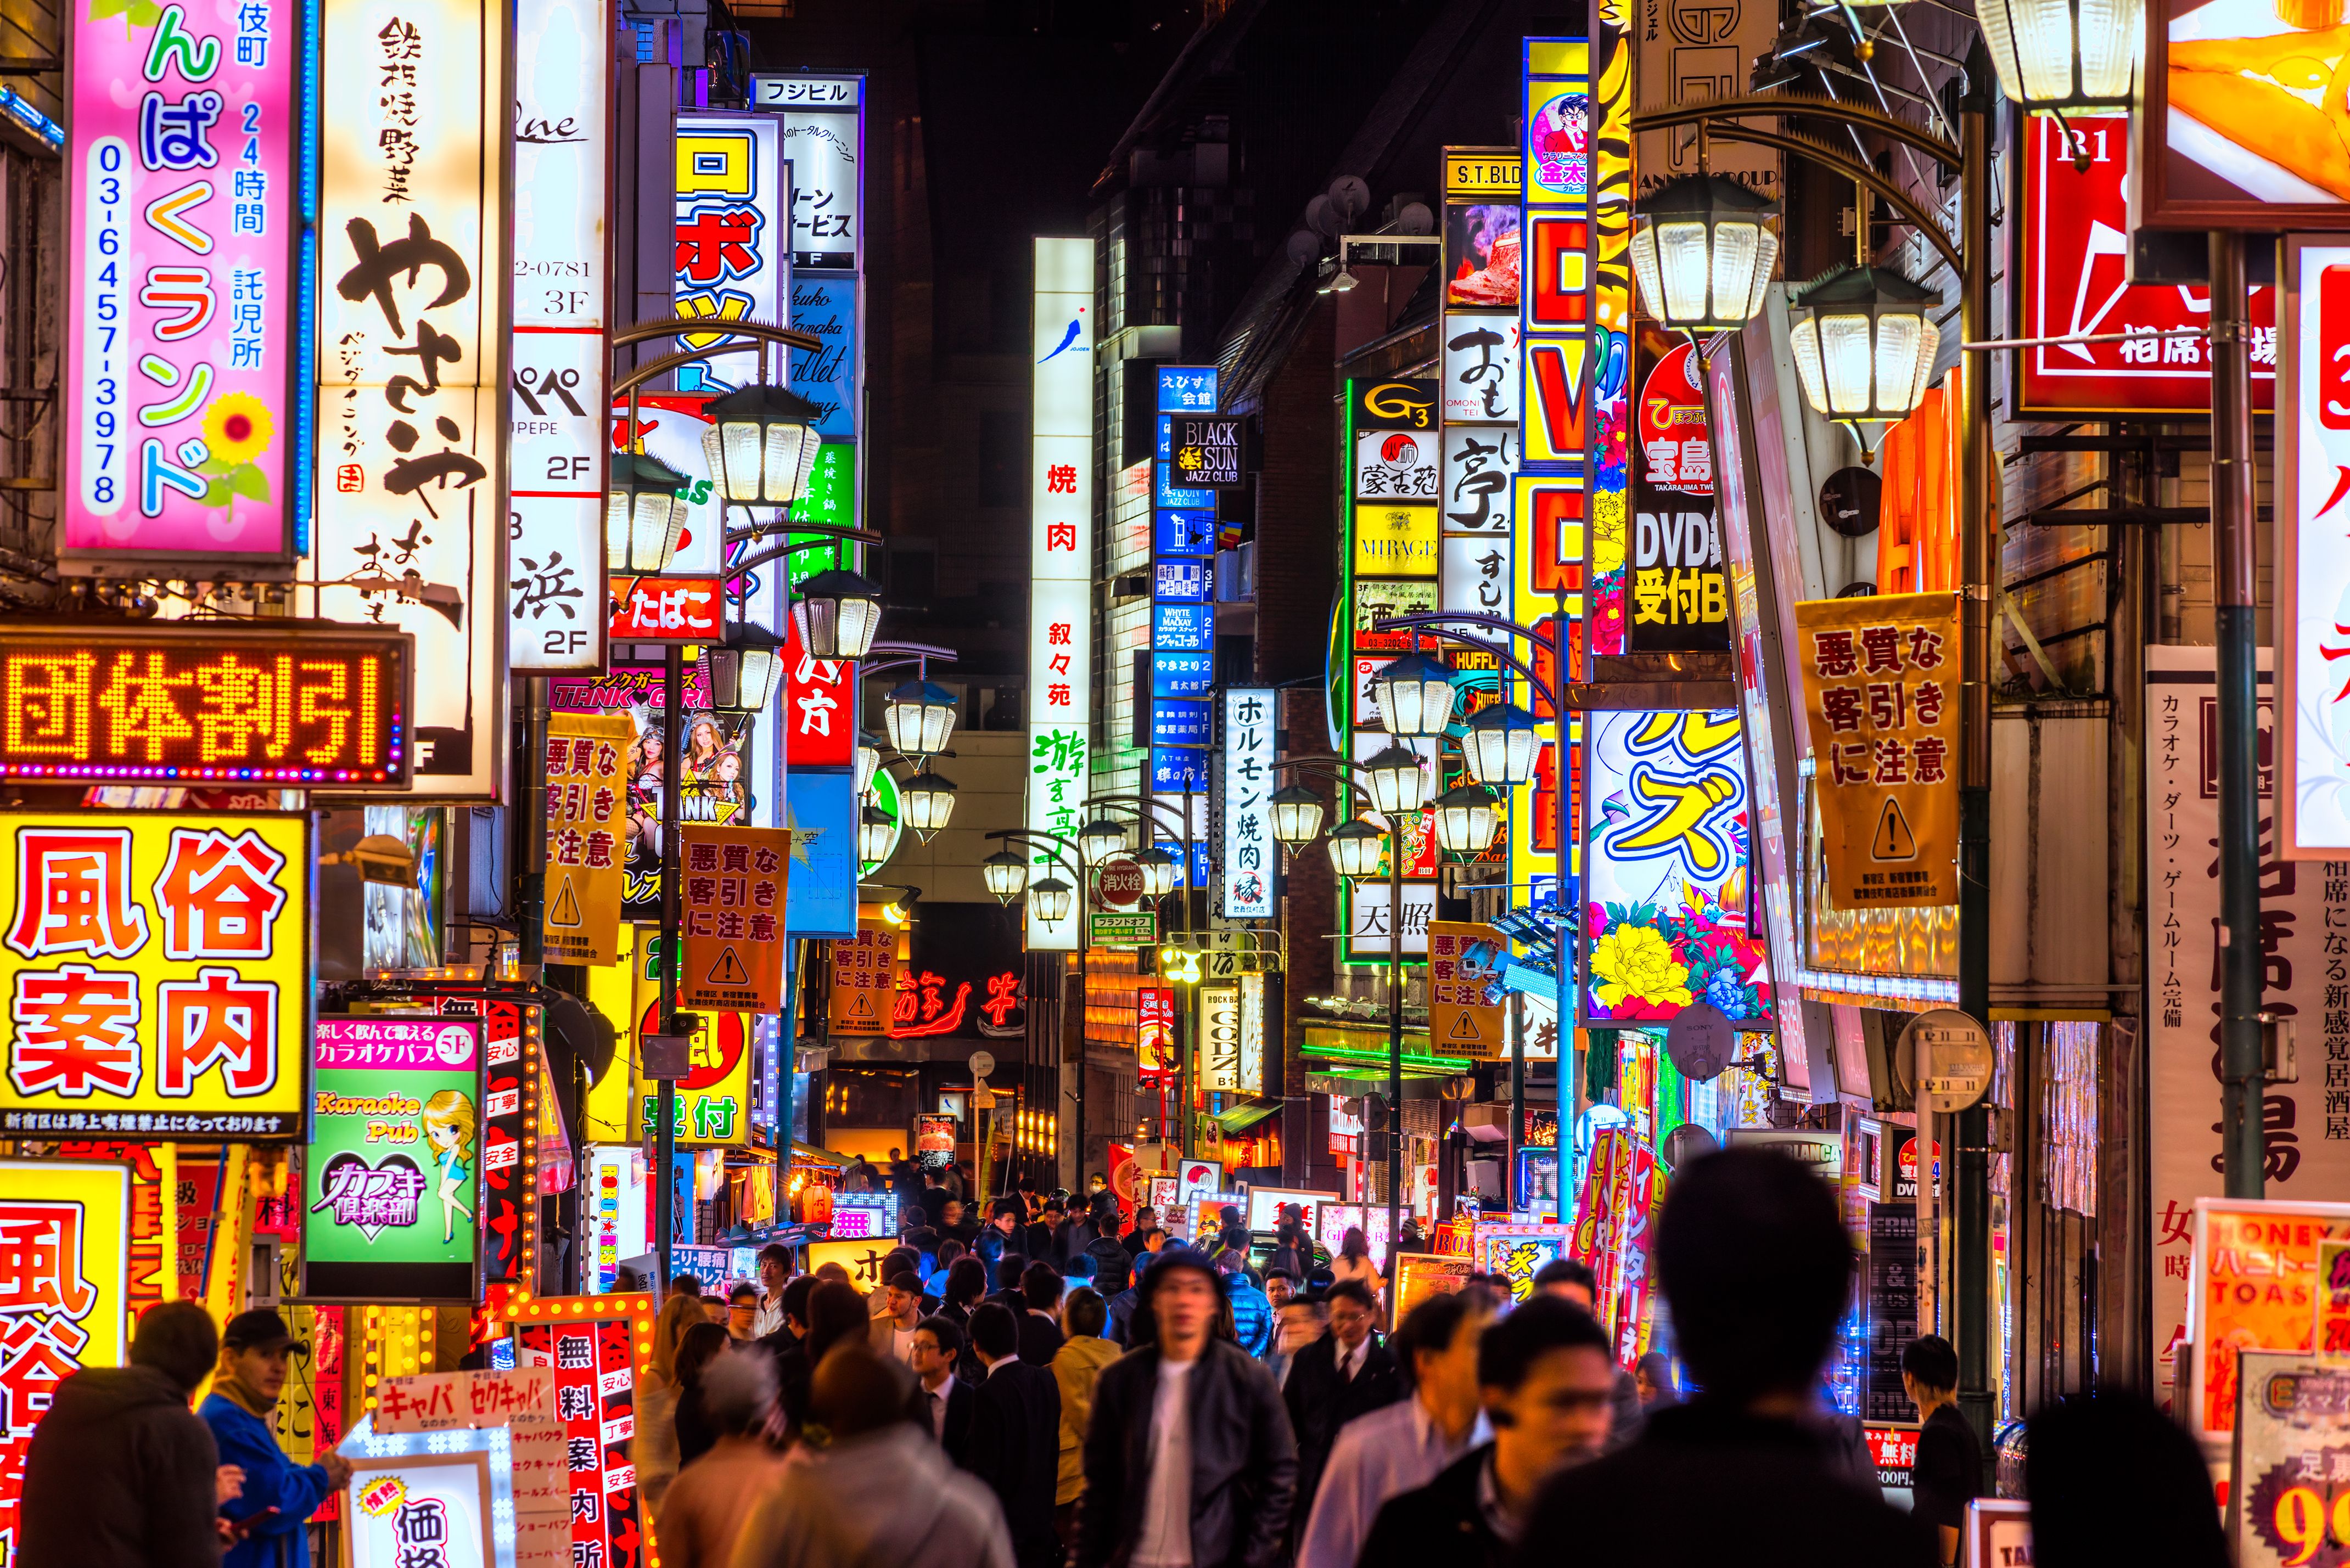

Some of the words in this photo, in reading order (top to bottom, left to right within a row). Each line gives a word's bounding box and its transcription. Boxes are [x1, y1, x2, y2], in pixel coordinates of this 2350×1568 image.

[236, 0, 269, 68] 伎町
[767, 83, 848, 102] フジビル
[378, 16, 423, 205] 鉄板焼野菜
[231, 103, 267, 235] 24時間
[1540, 161, 1588, 186] 金太
[543, 289, 590, 314] 3F
[94, 144, 121, 503] 03-6457-3978
[228, 268, 266, 370] 託児所
[336, 211, 487, 519] やさいや
[339, 331, 364, 457] ベジダイニング
[1161, 375, 1204, 389] えびす
[1181, 391, 1211, 406] 会館
[1446, 399, 1480, 407] OMONI
[1185, 422, 1238, 446] BLACK
[1204, 446, 1238, 470] SUN
[1386, 441, 1415, 464] 火鍋
[1646, 436, 1712, 483] 宝島
[547, 456, 590, 480] 2F
[1186, 470, 1211, 482] JAZZ
[1212, 470, 1238, 482] CLUB
[1360, 465, 1438, 495] 蒙古苑
[1446, 437, 1507, 529] 亭
[1654, 483, 1698, 492] TAKARAJIMA
[1047, 464, 1077, 552] 焼肉
[1361, 539, 1437, 557] MIRAGE
[1636, 512, 1722, 568] DVD
[1159, 566, 1174, 580] 麻雀
[1192, 567, 1199, 579] 3F
[1204, 569, 1213, 592] 3F
[1158, 582, 1199, 595] 紳士倶楽部
[631, 589, 713, 630] たばこ
[1163, 617, 1192, 626] MACKAY
[1164, 608, 1190, 617] WHYTE
[1204, 617, 1212, 639] 2F
[543, 630, 588, 655] 2F
[1813, 625, 1944, 679] 悪質な
[1048, 622, 1072, 706] 叙々苑
[1156, 660, 1199, 671] やきとり
[1449, 651, 1499, 670] SHUFFL
[5, 652, 382, 765] 団体割引
[554, 685, 632, 709] TANK
[1820, 681, 1944, 734] 客引き
[1156, 725, 1198, 734] 梅屋薬局
[546, 738, 617, 779] 悪質な
[1830, 735, 1947, 787] に注意
[1237, 697, 1263, 871] ホルモン焼肉
[1421, 813, 1434, 833] 和風
[689, 842, 780, 875] 悪質な
[1414, 835, 1426, 859] パブ
[2162, 695, 2181, 1028] カラオケ・ダーツ・ゲームルーム完備
[3, 825, 287, 960] 風俗
[688, 876, 777, 908] 客引き
[1103, 873, 1142, 892] 消火栓
[1099, 918, 1146, 926] ブランドオフ
[1233, 906, 1265, 914] 歌舞伎町店
[1356, 902, 1432, 936] 天照
[686, 909, 777, 943] に注意
[835, 949, 893, 968] 客引き
[834, 969, 892, 990] に注意
[696, 990, 717, 998] 新宿区
[1207, 996, 1227, 1004] ROCK
[6, 963, 279, 1098] 案内
[316, 1024, 436, 1041] 楽しく飲んで歌える
[316, 1043, 436, 1063] カラオケパブ
[439, 1033, 469, 1055] 5F
[486, 1044, 518, 1063] 安心
[1218, 1077, 1233, 1086] B1
[315, 1091, 421, 1116] Karaoke
[487, 1094, 517, 1114] 丁寧
[365, 1119, 419, 1145] Pub
[486, 1145, 518, 1165] 安全
[599, 1164, 620, 1221] ROBOT
[333, 1195, 418, 1227] 倶楽部
[2212, 1222, 2334, 1246] HONEY
[603, 1373, 631, 1392] 安心
[382, 1384, 454, 1420] キャバ
[605, 1420, 633, 1440] 丁寧
[556, 1334, 603, 1568] 無料案内所
[607, 1469, 636, 1489] 安全
